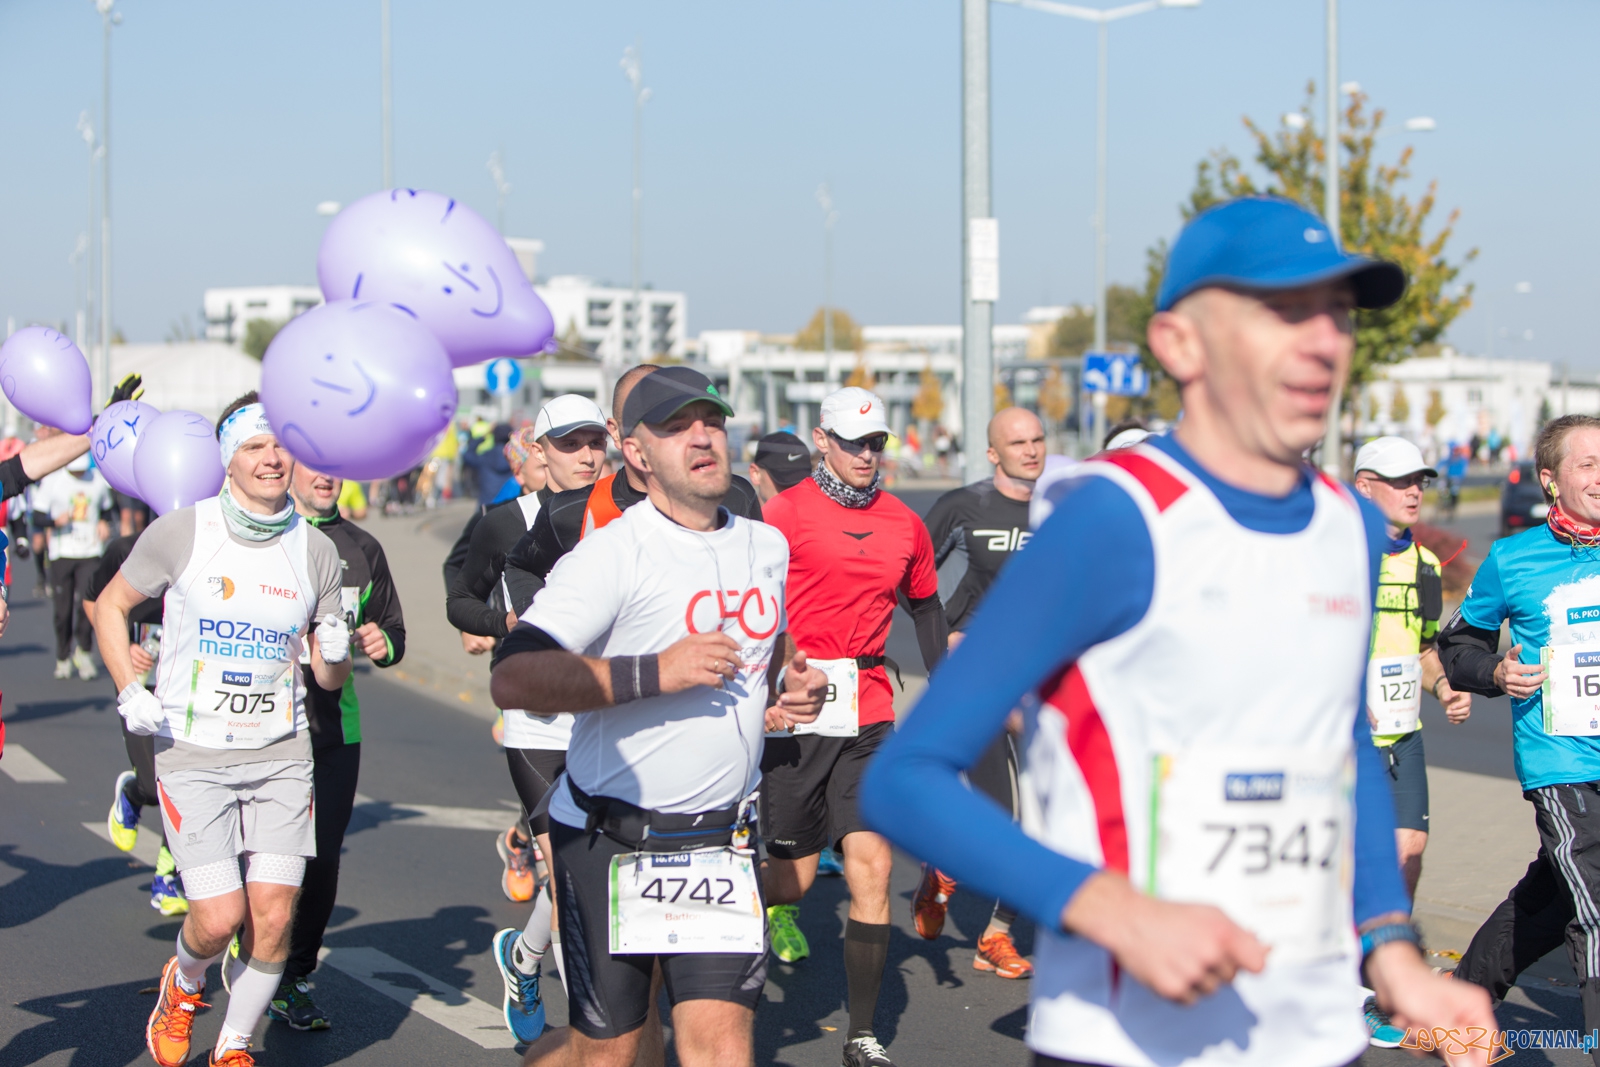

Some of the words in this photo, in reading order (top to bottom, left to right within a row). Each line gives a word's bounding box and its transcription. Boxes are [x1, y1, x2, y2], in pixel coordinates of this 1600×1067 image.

[258, 584, 299, 601] TIMEX
[213, 690, 276, 715] 7075
[1380, 680, 1417, 702] 1227
[640, 877, 737, 905] 4742
